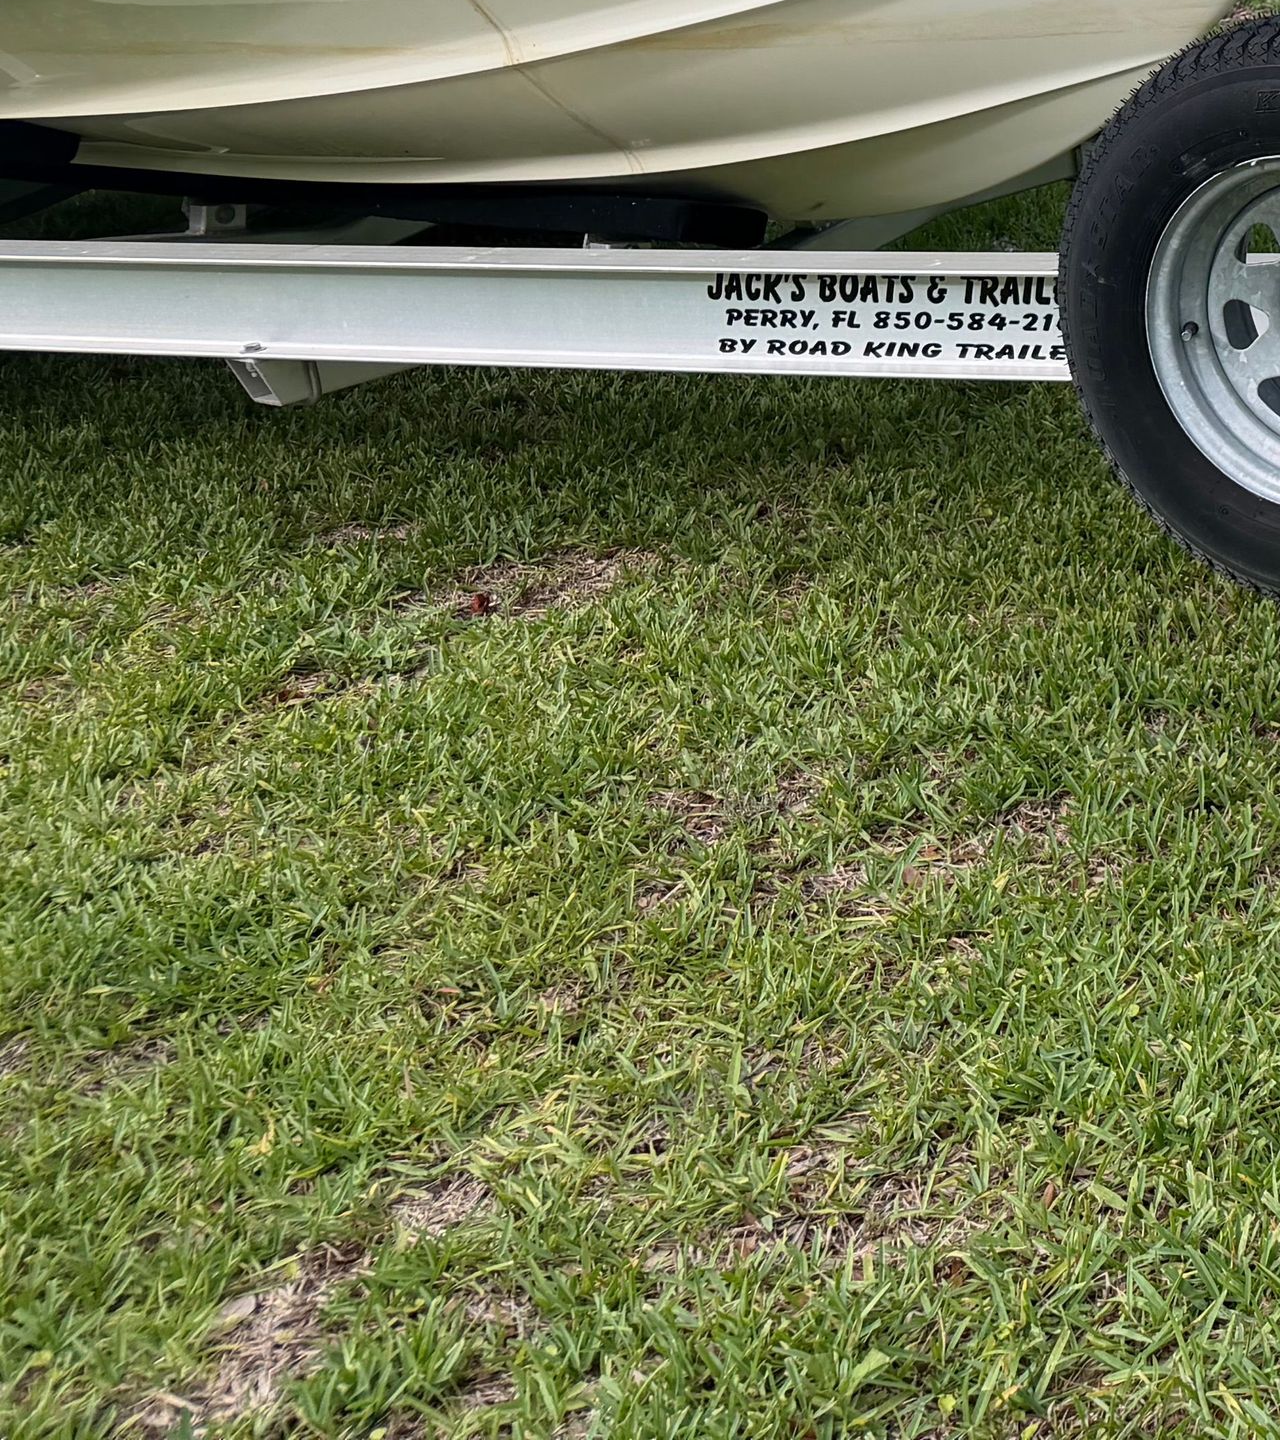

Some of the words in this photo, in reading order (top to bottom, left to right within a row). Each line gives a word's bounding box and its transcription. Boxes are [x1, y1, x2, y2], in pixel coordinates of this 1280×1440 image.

[707, 273, 807, 302] JACK'S
[817, 275, 916, 303] BOATS
[926, 276, 948, 304] &
[725, 308, 820, 331] PERRY,
[831, 311, 861, 329] FL
[872, 311, 1062, 331] 850-584-21
[718, 338, 757, 354] BY
[766, 340, 852, 356] ROAD
[862, 342, 943, 358] KING
